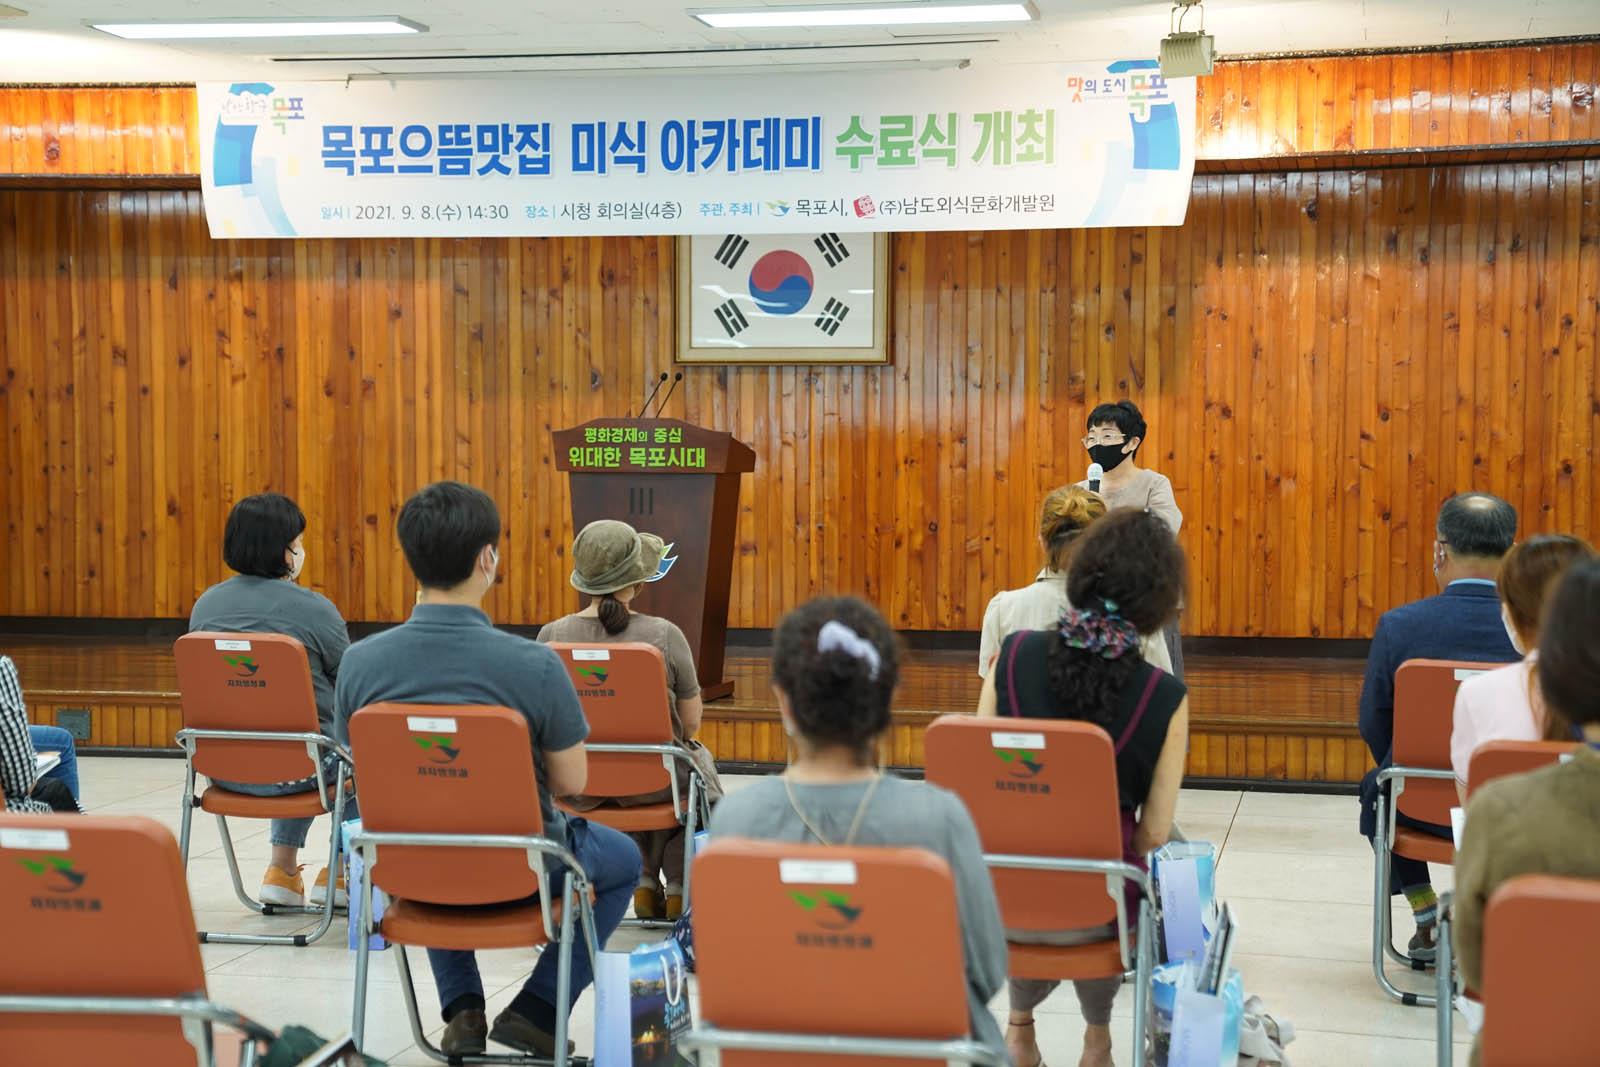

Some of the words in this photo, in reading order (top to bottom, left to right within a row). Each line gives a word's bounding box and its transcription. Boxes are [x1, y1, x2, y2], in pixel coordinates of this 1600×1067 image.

[1067, 76, 1097, 103] 맛의
[1102, 78, 1126, 93] 도시
[1127, 74, 1168, 117] 목포
[271, 97, 304, 136] 목포
[321, 123, 551, 176] 목포으뜸맛집
[571, 120, 647, 175] 미식
[660, 116, 821, 173] 아카데미
[835, 112, 957, 169] 수료식
[971, 109, 1056, 165] 개최
[320, 206, 344, 220] 일시
[355, 205, 396, 221] 2021.
[401, 205, 415, 221] 9.
[467, 204, 509, 220] 14:30
[525, 204, 549, 219] 장소
[560, 202, 592, 221] 시청
[597, 201, 682, 221] 회의실(4층)
[728, 201, 752, 216] 주최
[796, 198, 848, 217] 목포시,
[879, 194, 1055, 215] (주)남도외식문화개발원
[584, 427, 648, 443] 평화경제의
[653, 427, 682, 443] 중심
[569, 447, 622, 467] 위대한
[629, 447, 706, 467] 목포시대
